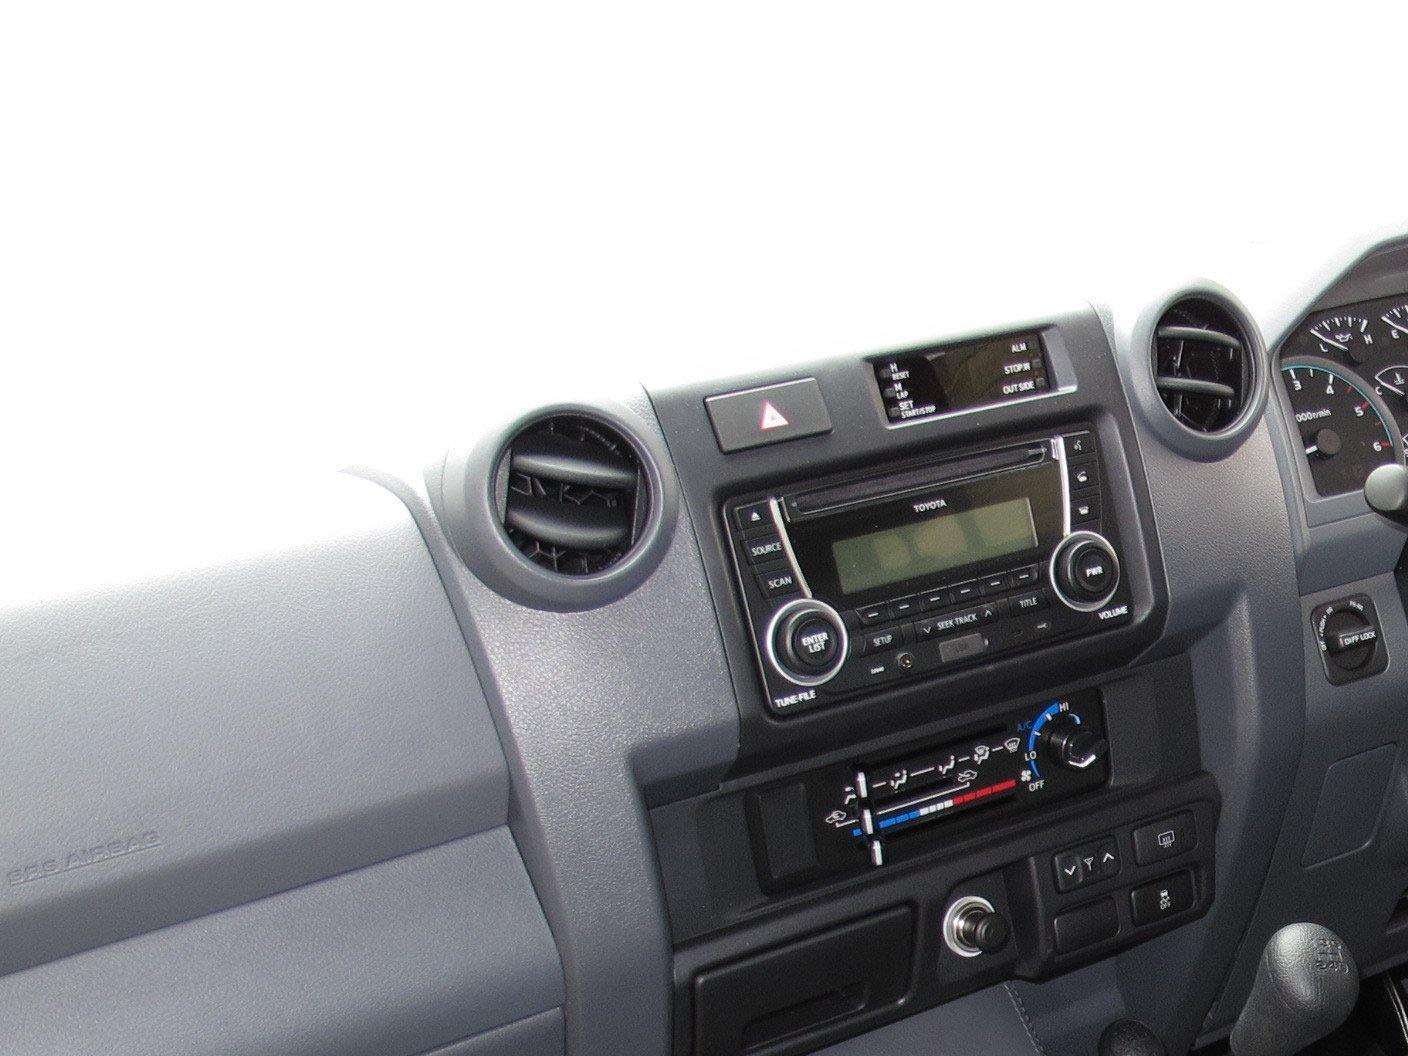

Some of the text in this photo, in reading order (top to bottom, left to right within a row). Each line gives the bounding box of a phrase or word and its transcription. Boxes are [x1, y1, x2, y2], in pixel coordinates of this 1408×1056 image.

[1363, 334, 1373, 345] H
[1391, 329, 1399, 339] E
[1011, 342, 1027, 353] ALM
[1319, 343, 1328, 352] L
[890, 362, 898, 372] H
[1293, 380, 1302, 391] 3
[1326, 384, 1334, 395] 4
[1375, 386, 1383, 396] C
[896, 390, 908, 400] LAP
[899, 400, 913, 410] SET
[1354, 406, 1364, 417] 5
[1373, 441, 1382, 452] 6
[913, 499, 947, 513] TOYOTA
[751, 541, 782, 556] SOURCE
[1086, 565, 1103, 577] PWR
[768, 575, 792, 589] SCAN
[1020, 597, 1038, 609] TITLE
[1098, 605, 1128, 620] VOLUME
[801, 632, 829, 646] ENTER
[873, 634, 892, 647] SETUP
[1344, 630, 1376, 646] DIFF LOCK
[808, 642, 826, 654] LIST
[1059, 702, 1069, 712] HI
[1025, 751, 1037, 762] LO
[1028, 780, 1045, 792] OFF
